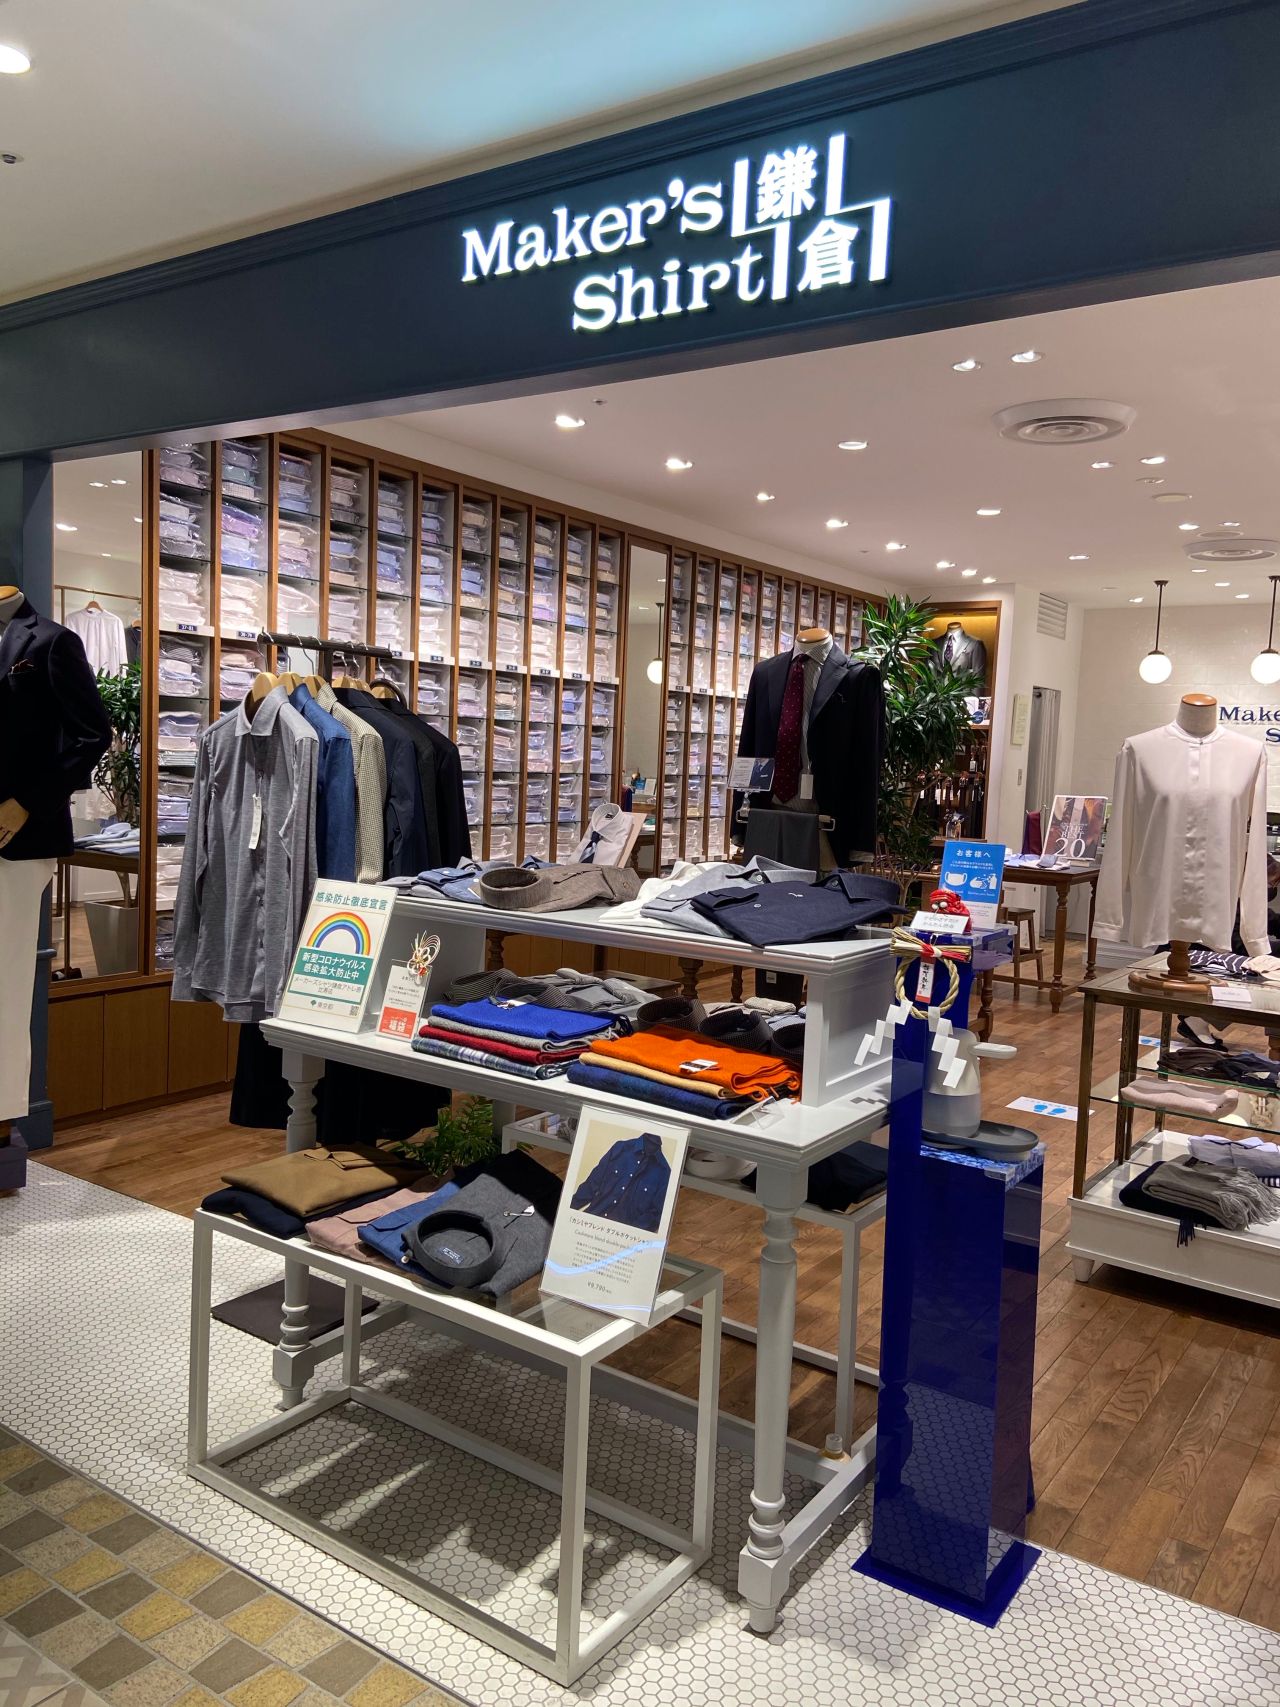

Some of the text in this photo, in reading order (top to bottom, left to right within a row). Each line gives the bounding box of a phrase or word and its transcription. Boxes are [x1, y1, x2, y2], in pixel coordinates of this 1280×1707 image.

[756, 145, 859, 293] 鎌倉
[461, 178, 722, 283] Maker's
[572, 241, 765, 332] Shirt
[1065, 825, 1084, 833] THE
[956, 849, 991, 858] お客様へ
[1053, 837, 1086, 858] 20
[315, 891, 388, 911] 感染防止徹底宣言
[302, 952, 366, 971] 新型コロナウイルス
[303, 963, 359, 980] 感染拡大防止中
